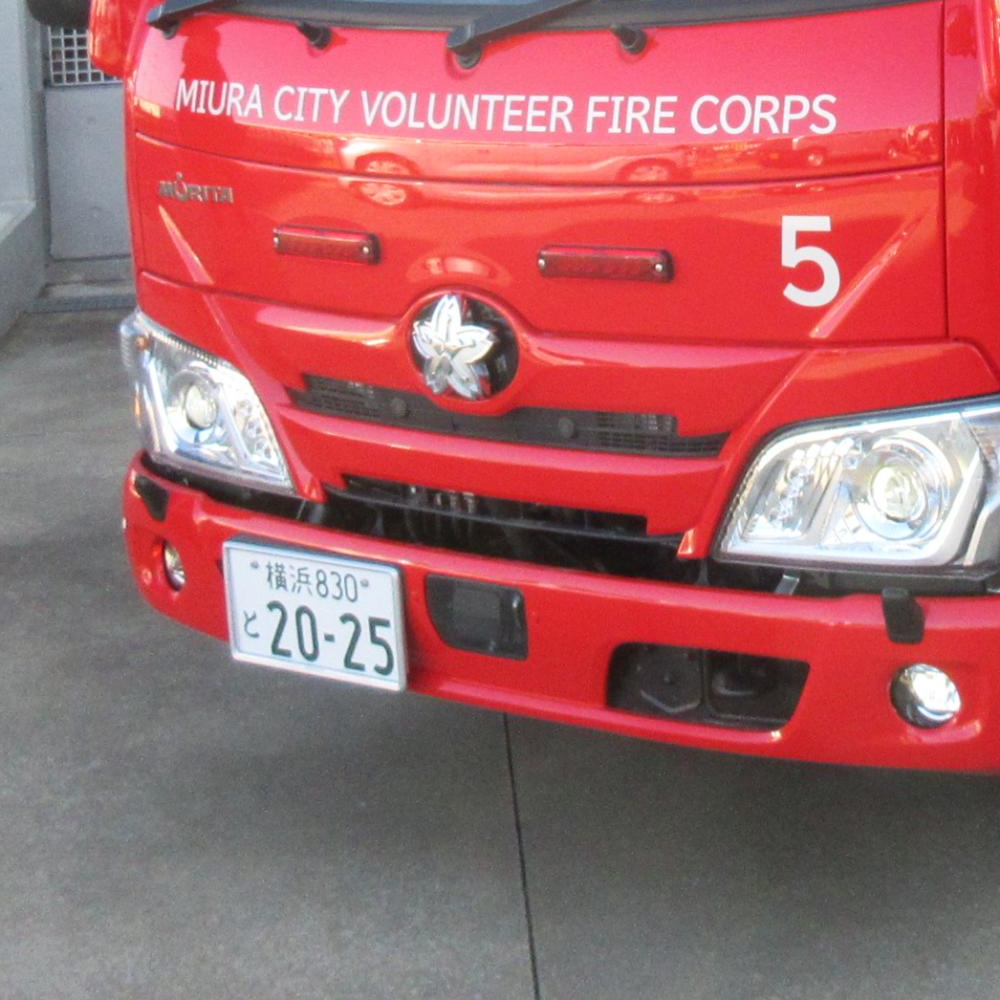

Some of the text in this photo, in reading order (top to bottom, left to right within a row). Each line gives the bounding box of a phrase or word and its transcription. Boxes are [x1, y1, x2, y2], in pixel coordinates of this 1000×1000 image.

[176, 78, 838, 135] MIURA CITY VOLUNTEER FIRE CORPS
[781, 215, 841, 308] 5
[243, 600, 395, 677] と 20-25
